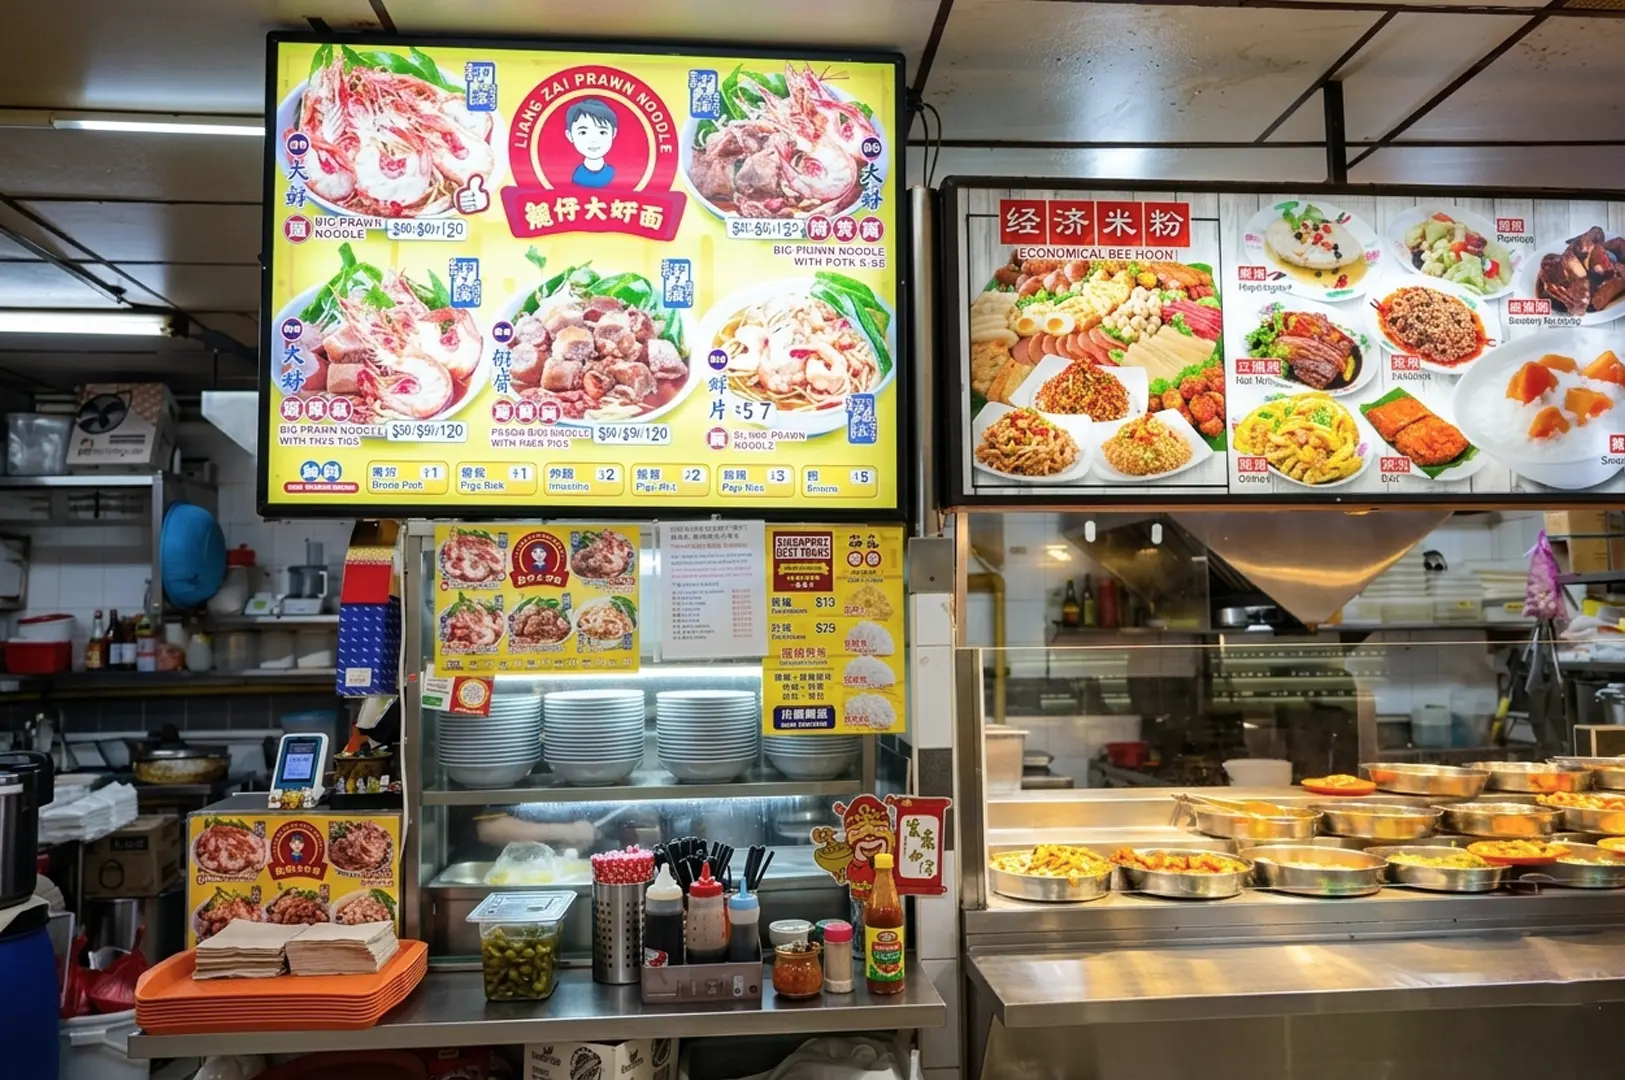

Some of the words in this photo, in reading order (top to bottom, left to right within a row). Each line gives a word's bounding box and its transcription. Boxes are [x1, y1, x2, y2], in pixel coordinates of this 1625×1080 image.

[514, 100, 543, 149] LIANG
[541, 77, 570, 101] ZAI
[574, 72, 636, 96] PRAWN
[636, 92, 672, 154] NOODLE
[1005, 207, 1184, 238] 经济米粉
[839, 247, 885, 257] NOODLE
[1019, 248, 1105, 260] ECONOMICAL
[1109, 249, 1132, 260] BEE
[1136, 250, 1173, 260] HOON
[794, 257, 822, 267] WITH
[280, 437, 306, 446] WITH
[491, 439, 516, 448] WITH
